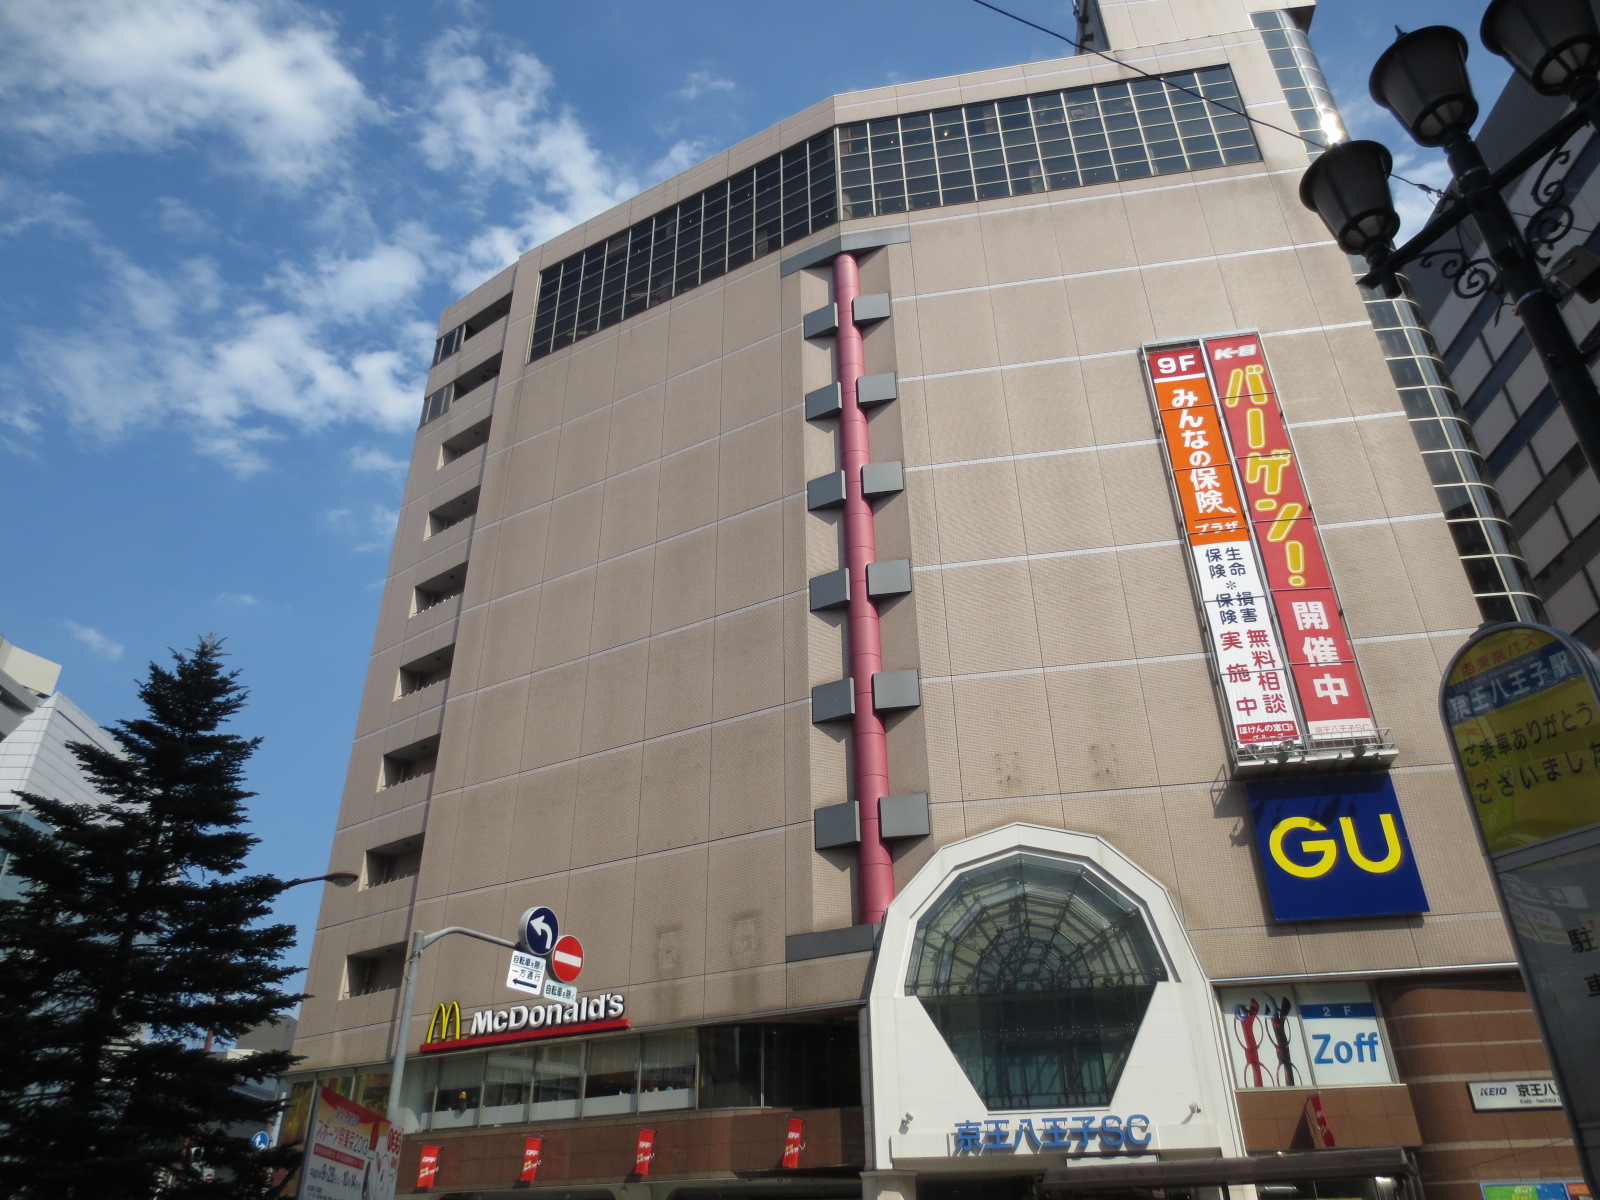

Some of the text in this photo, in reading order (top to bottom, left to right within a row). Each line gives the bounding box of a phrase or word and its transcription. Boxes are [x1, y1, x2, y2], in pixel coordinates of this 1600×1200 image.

[1157, 354, 1196, 374] 9F
[1195, 519, 1238, 536] プラザ
[1291, 601, 1350, 705] 開催中
[1461, 635, 1539, 676] 西東京バス
[1449, 649, 1574, 720] 京王八王子駅
[1269, 813, 1402, 879] GU
[512, 969, 541, 982] 一方通行
[513, 955, 544, 970] 自転車を除く
[546, 984, 575, 1000] 自転車を除く
[470, 993, 624, 1036] McDonald's
[1311, 1032, 1379, 1066] Zoff
[1480, 1087, 1508, 1097] KEIO
[1516, 1083, 1558, 1097] 京王八
[954, 1114, 1152, 1150] 京王八王子SC
